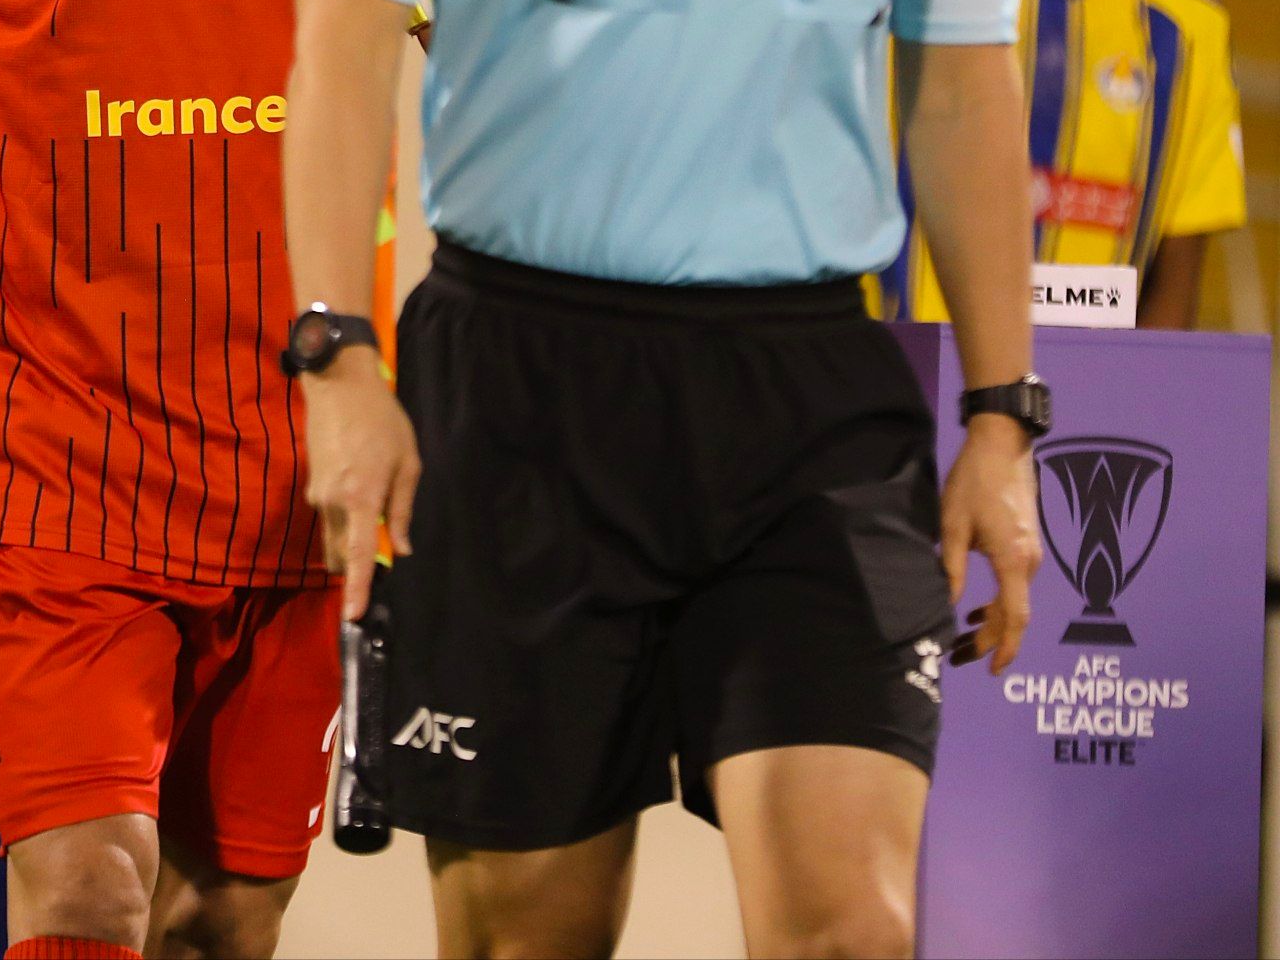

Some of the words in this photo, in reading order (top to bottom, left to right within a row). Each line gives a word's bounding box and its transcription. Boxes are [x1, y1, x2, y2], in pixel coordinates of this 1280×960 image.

[1074, 653, 1121, 678] AFC
[1003, 674, 1190, 709] CHAMPIONS
[392, 706, 478, 761] AFC
[1036, 705, 1155, 738] LEAGUE
[1053, 739, 1137, 766] ELITE
